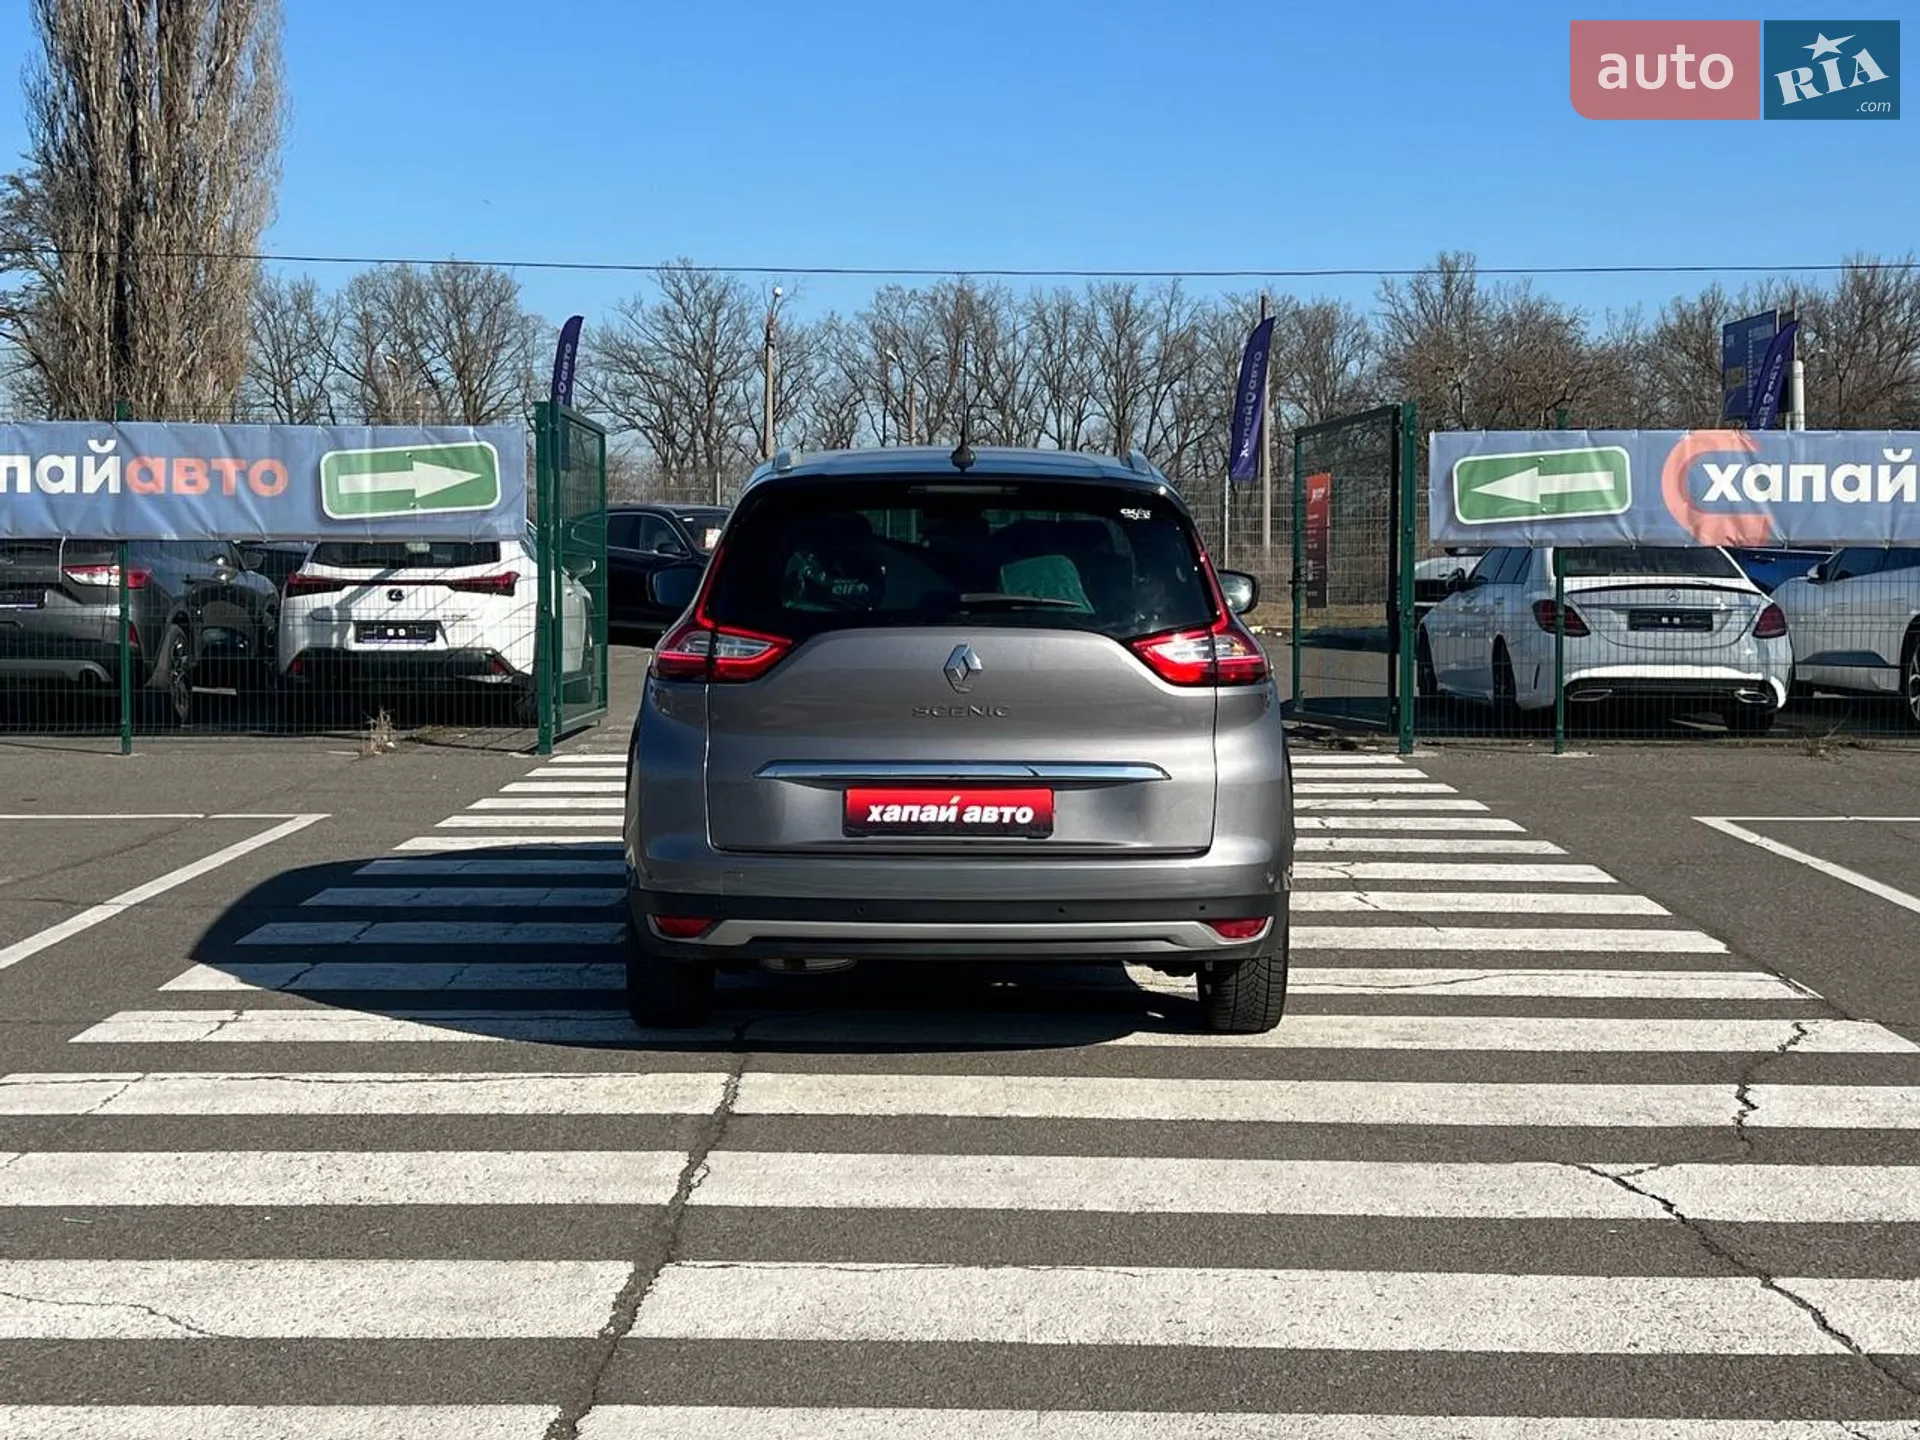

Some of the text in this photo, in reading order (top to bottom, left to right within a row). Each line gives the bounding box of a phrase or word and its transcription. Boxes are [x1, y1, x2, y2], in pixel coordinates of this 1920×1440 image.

[1702, 447, 1917, 503] хапай
[912, 704, 1010, 719] SCENIC
[867, 796, 1034, 824] хапай авто
